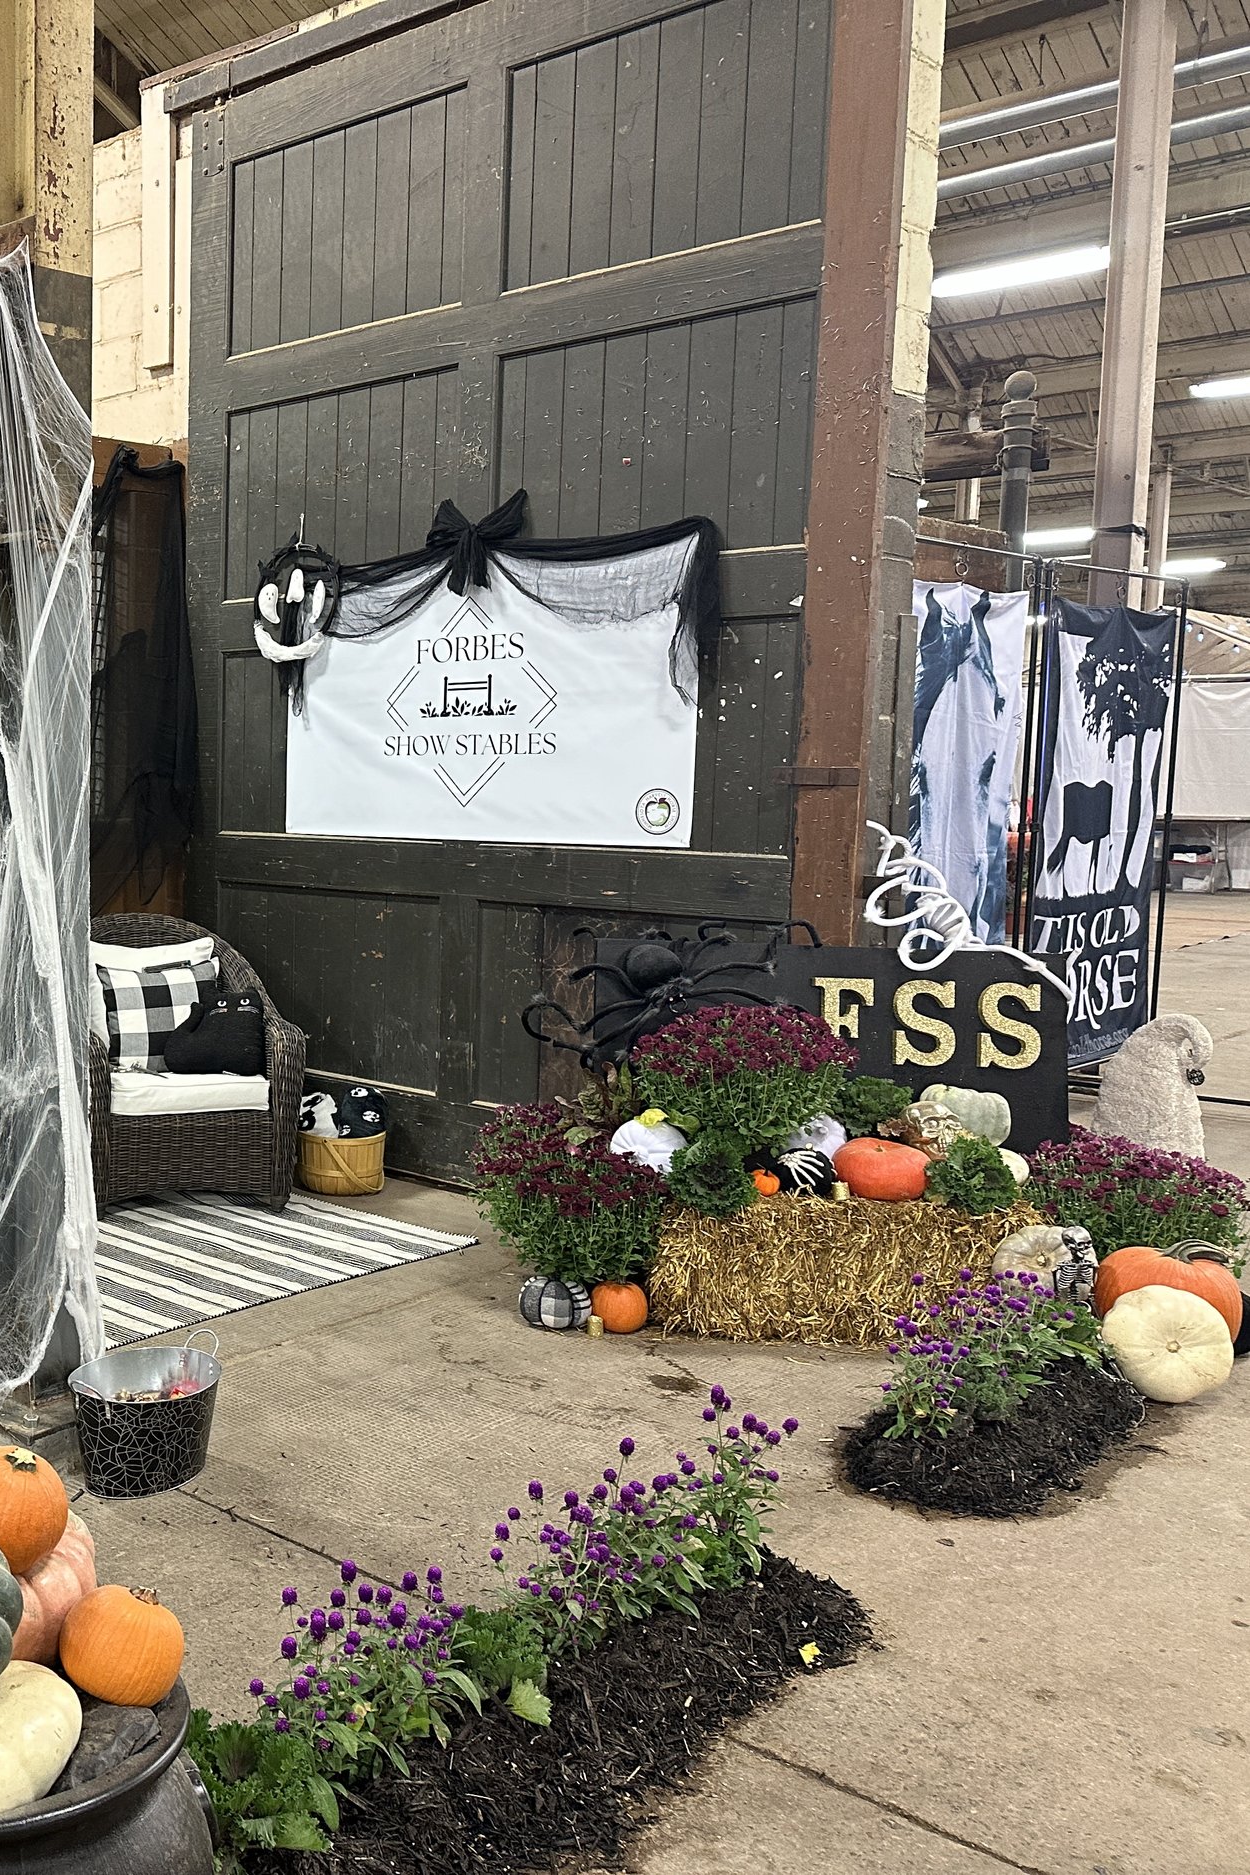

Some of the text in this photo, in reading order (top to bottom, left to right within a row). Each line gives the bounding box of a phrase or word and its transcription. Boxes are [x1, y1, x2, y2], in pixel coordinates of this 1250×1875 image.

[417, 632, 524, 664] FORBES
[384, 732, 557, 756] SHOW STABLES
[1090, 905, 1140, 948] OLD
[812, 977, 1042, 1070] FSS
